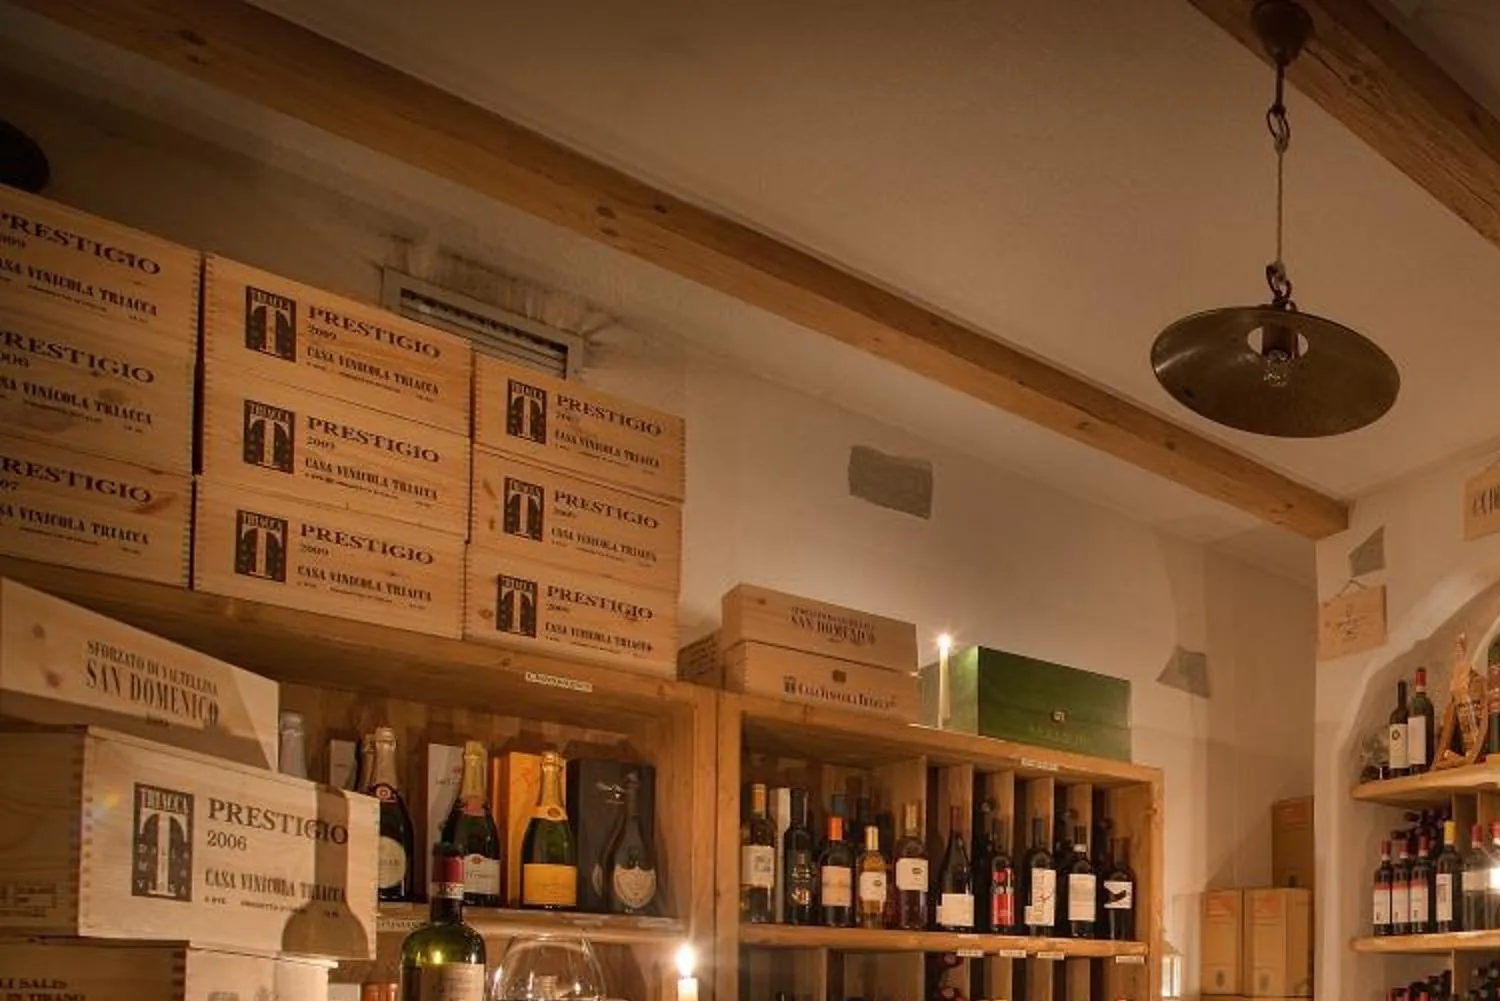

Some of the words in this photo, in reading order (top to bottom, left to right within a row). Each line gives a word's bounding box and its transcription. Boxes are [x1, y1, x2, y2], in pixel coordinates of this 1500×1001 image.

[308, 304, 441, 359] PRESTIGIO
[0, 330, 155, 384] RESTIGIO
[556, 393, 663, 437] PRESTIGIO
[307, 415, 440, 463] PRESTIGIO
[0, 455, 153, 508] RESTIGIO
[554, 490, 660, 529] PRESTIGIO
[300, 522, 434, 565] PRESTIGIO
[546, 584, 654, 620] PRESTIGIO
[87, 640, 145, 671] SFORZATO
[86, 659, 122, 697] SAN
[130, 671, 220, 728] DOMENICO
[206, 829, 248, 852] 2006
[207, 797, 349, 845] PRESTIGIO
[204, 868, 238, 890] CASA
[240, 871, 296, 896] VINICOLA
[19, 978, 68, 991] SALIS
